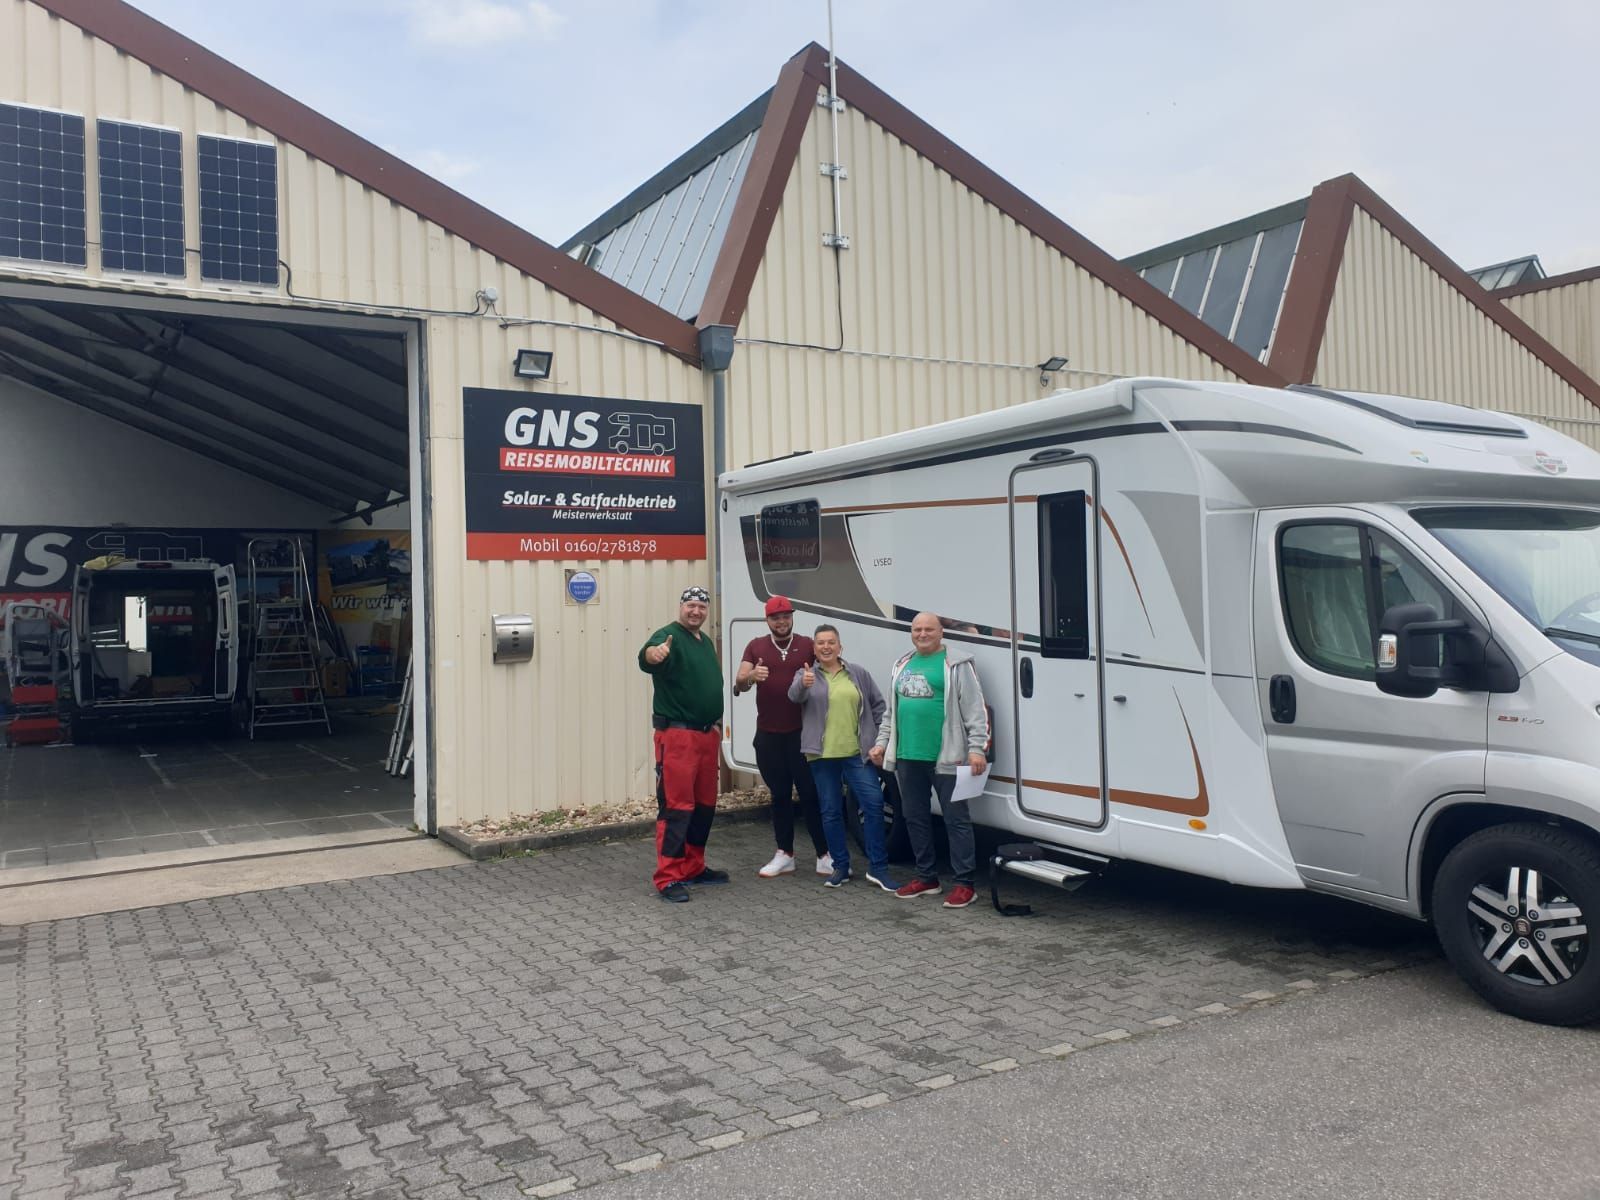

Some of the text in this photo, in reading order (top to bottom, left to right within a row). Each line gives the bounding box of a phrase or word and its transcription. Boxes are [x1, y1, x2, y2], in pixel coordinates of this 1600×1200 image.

[504, 407, 601, 449] GNS
[505, 452, 671, 473] REISEMOBILTECHNIK
[502, 490, 676, 510] Solar- & Satfachbetrieb
[552, 509, 632, 520] Meisterwerkstatt
[520, 537, 657, 555] Mobil 0160/2781878
[873, 557, 893, 567] LYSEO
[331, 594, 362, 609] Wir
